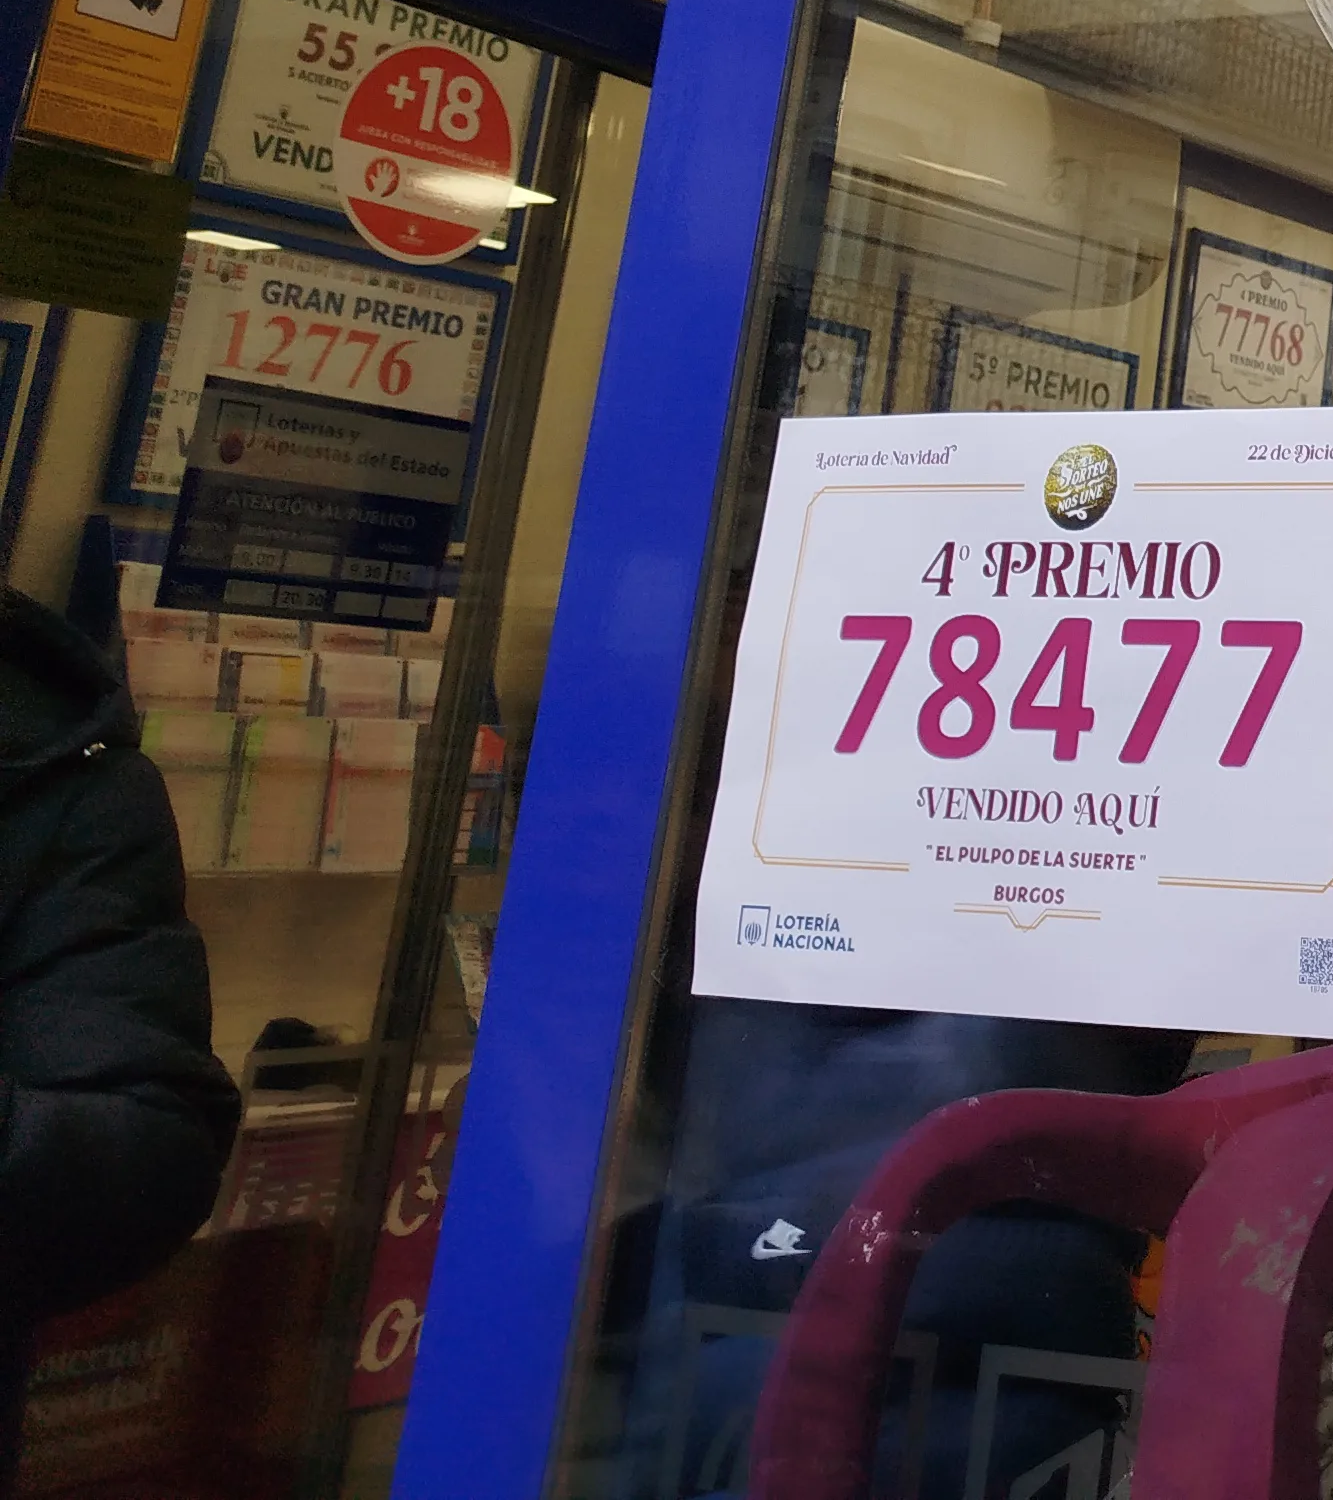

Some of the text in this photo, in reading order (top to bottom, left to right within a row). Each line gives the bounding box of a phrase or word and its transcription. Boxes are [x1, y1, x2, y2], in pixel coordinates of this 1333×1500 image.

[390, 7, 510, 64] PREMIO
[298, 69, 353, 92] ACIERTO
[386, 66, 484, 142] +18
[253, 130, 334, 174] VEND
[260, 279, 464, 339] GRAN PREMIO
[1248, 291, 1288, 312] PREMIO
[1215, 303, 1305, 367] 77768
[215, 309, 420, 397] 12776
[1229, 353, 1265, 371] VENDIDO
[968, 352, 1111, 409] 5º PREMIO
[267, 411, 362, 444] Loterías y
[390, 454, 451, 478] Estado
[871, 450, 889, 466] de
[891, 443, 958, 467] Navidad
[1247, 445, 1269, 461] 22
[1270, 444, 1292, 460] de
[1058, 458, 1109, 490] SORTEO
[1057, 494, 1079, 514] NOS
[1079, 483, 1105, 502] UNE
[920, 540, 1222, 600] 4º PREMIO
[833, 613, 1304, 768] 78477
[916, 786, 1161, 835] VENDIDO AQUÍ
[958, 847, 1015, 865] PULPO
[1018, 850, 1041, 866] DE
[1042, 851, 1065, 868] LA
[993, 885, 1065, 905] BURGOS
[775, 913, 841, 933] LOTERÍA
[772, 934, 856, 953] NACIONAL
